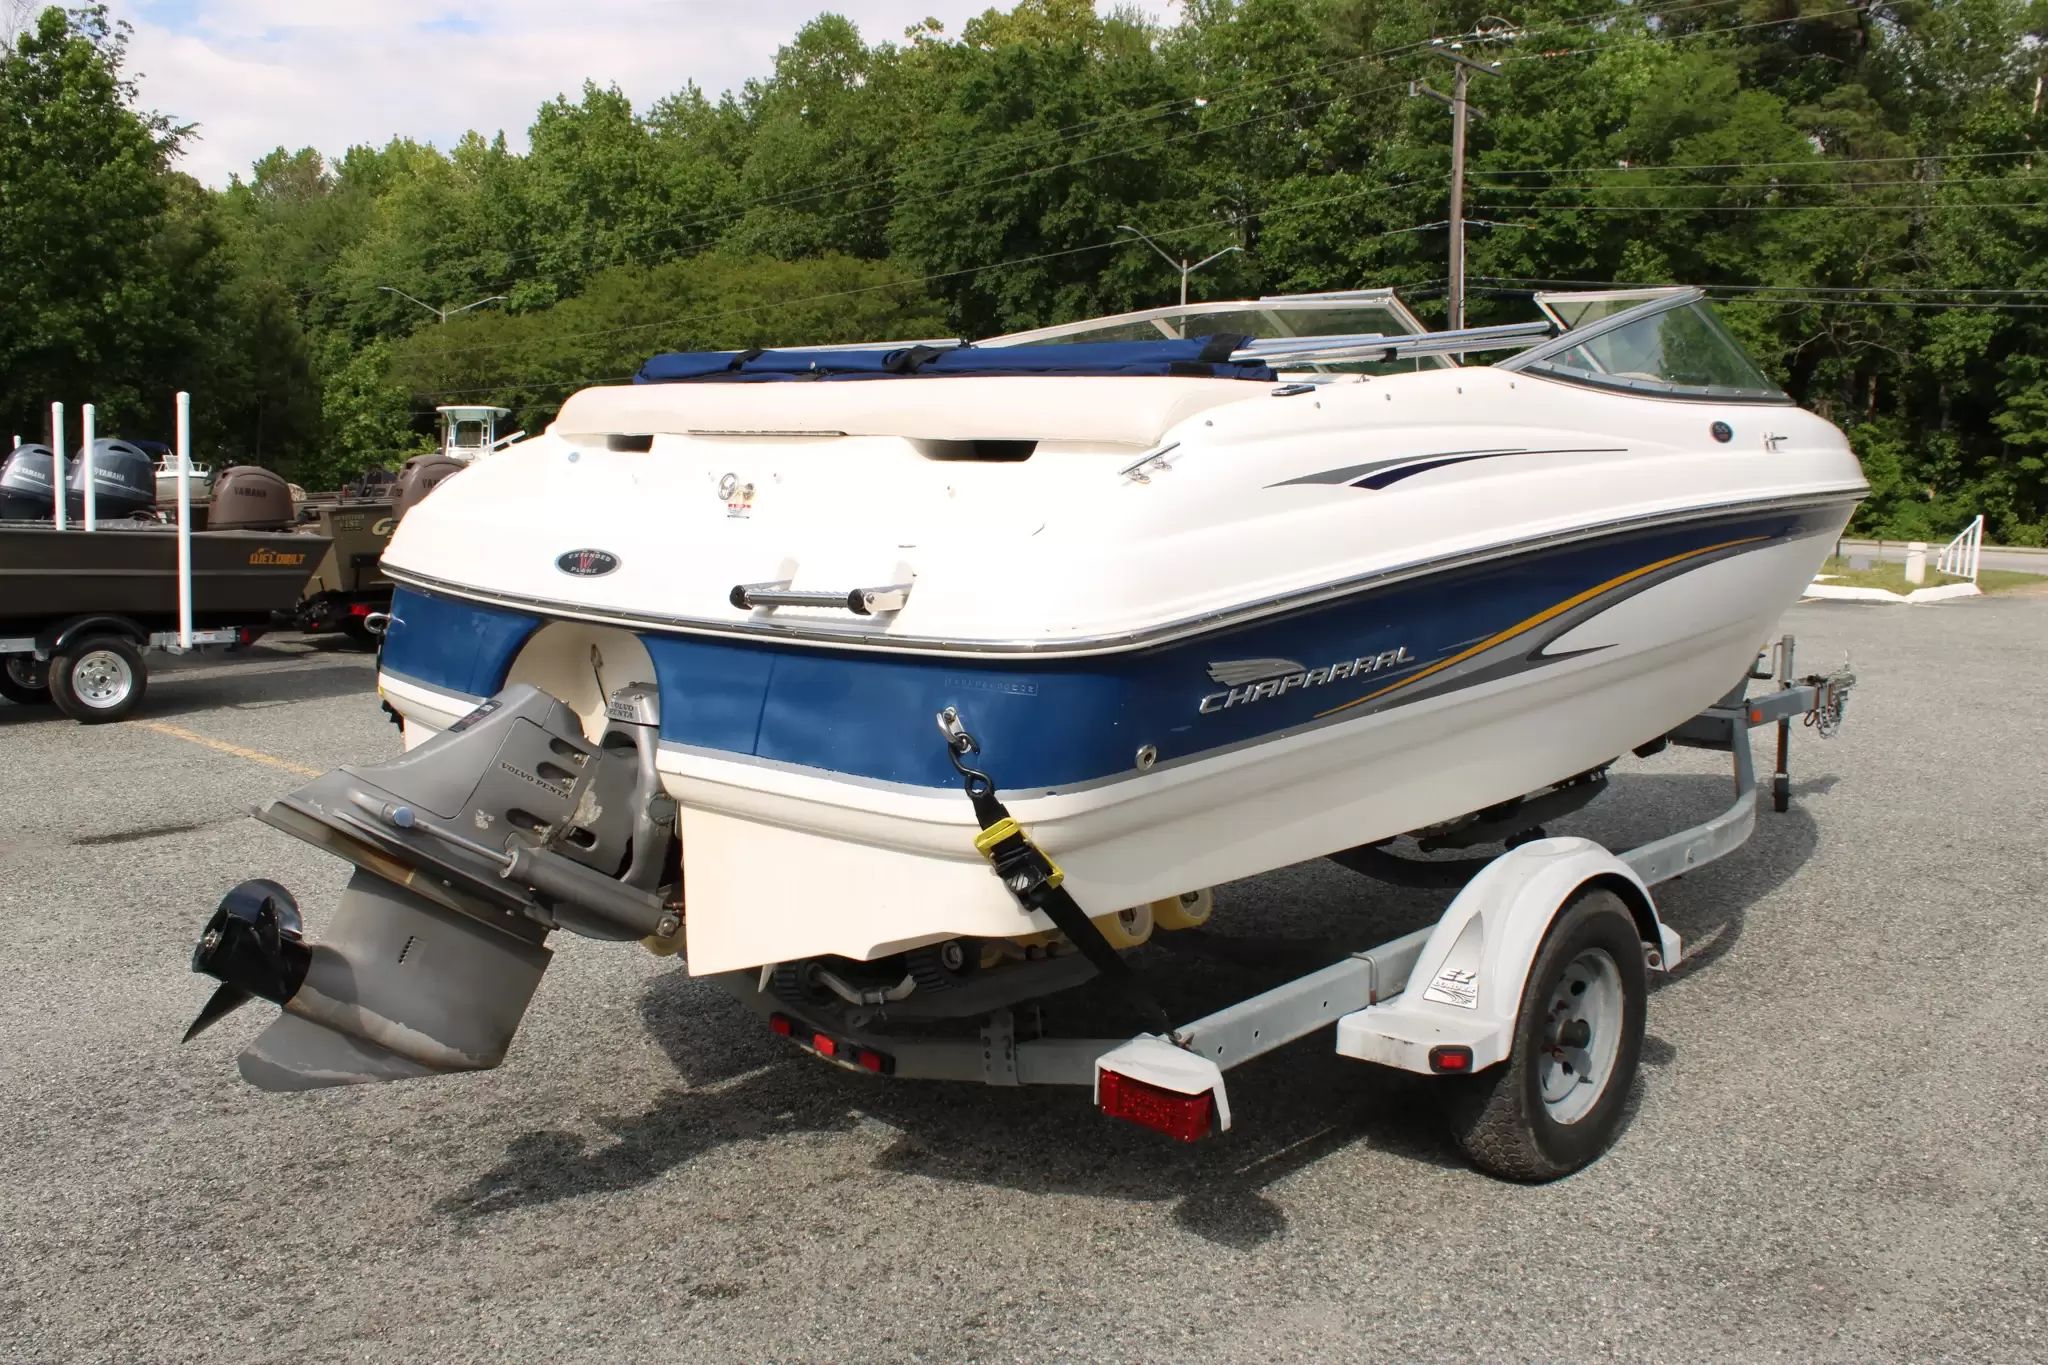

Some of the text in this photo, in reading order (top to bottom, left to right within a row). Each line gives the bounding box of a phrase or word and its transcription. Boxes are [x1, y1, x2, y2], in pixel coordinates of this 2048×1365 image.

[21, 467, 46, 480] YAMAHA
[99, 468, 125, 482] YAMAHA
[234, 487, 267, 498] YAMAHA
[568, 552, 611, 562] EXTENDED
[570, 566, 598, 574] PLANE
[1199, 646, 1415, 714] CHAPARRAL
[610, 701, 635, 712] VOLVO
[609, 708, 634, 719] PENTA
[501, 762, 571, 800] VOLVO PENTA
